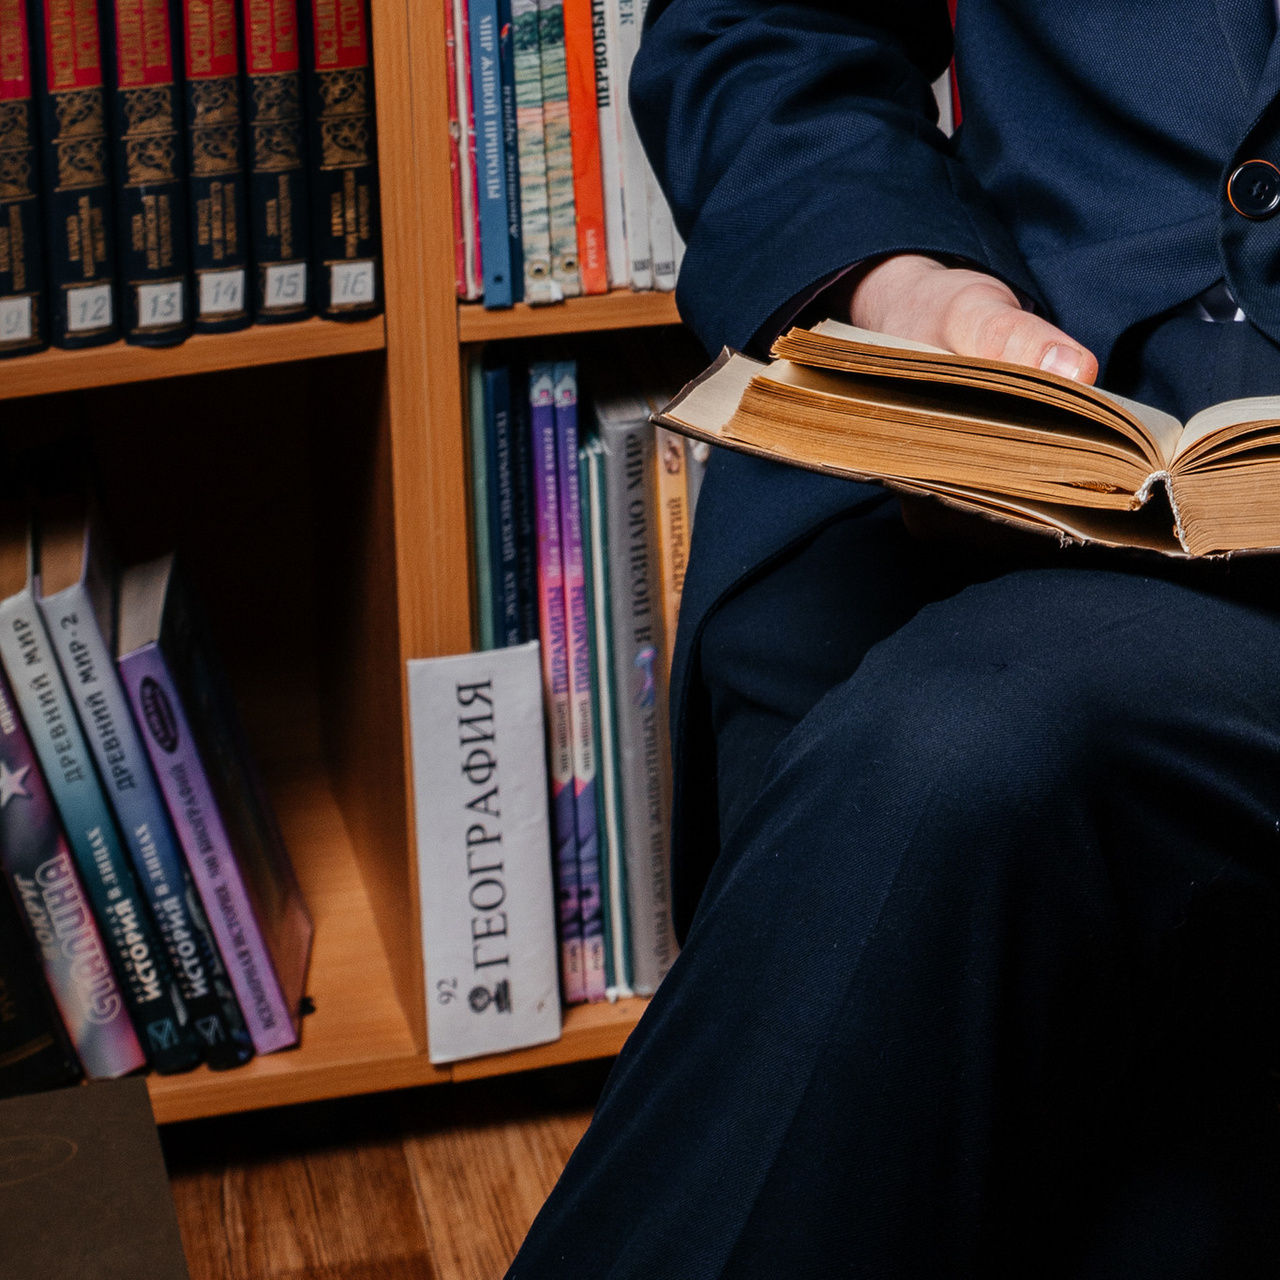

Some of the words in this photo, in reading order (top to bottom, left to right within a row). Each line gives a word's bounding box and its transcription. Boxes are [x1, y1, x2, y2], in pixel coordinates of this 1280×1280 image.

[11, 617, 44, 666] МИР
[30, 674, 85, 783] ДРЕВНИЙ
[86, 692, 136, 791] ДРЕВНИЙ
[457, 678, 510, 969] ГЕОГРАФИЯ
[436, 978, 458, 1004] 92
